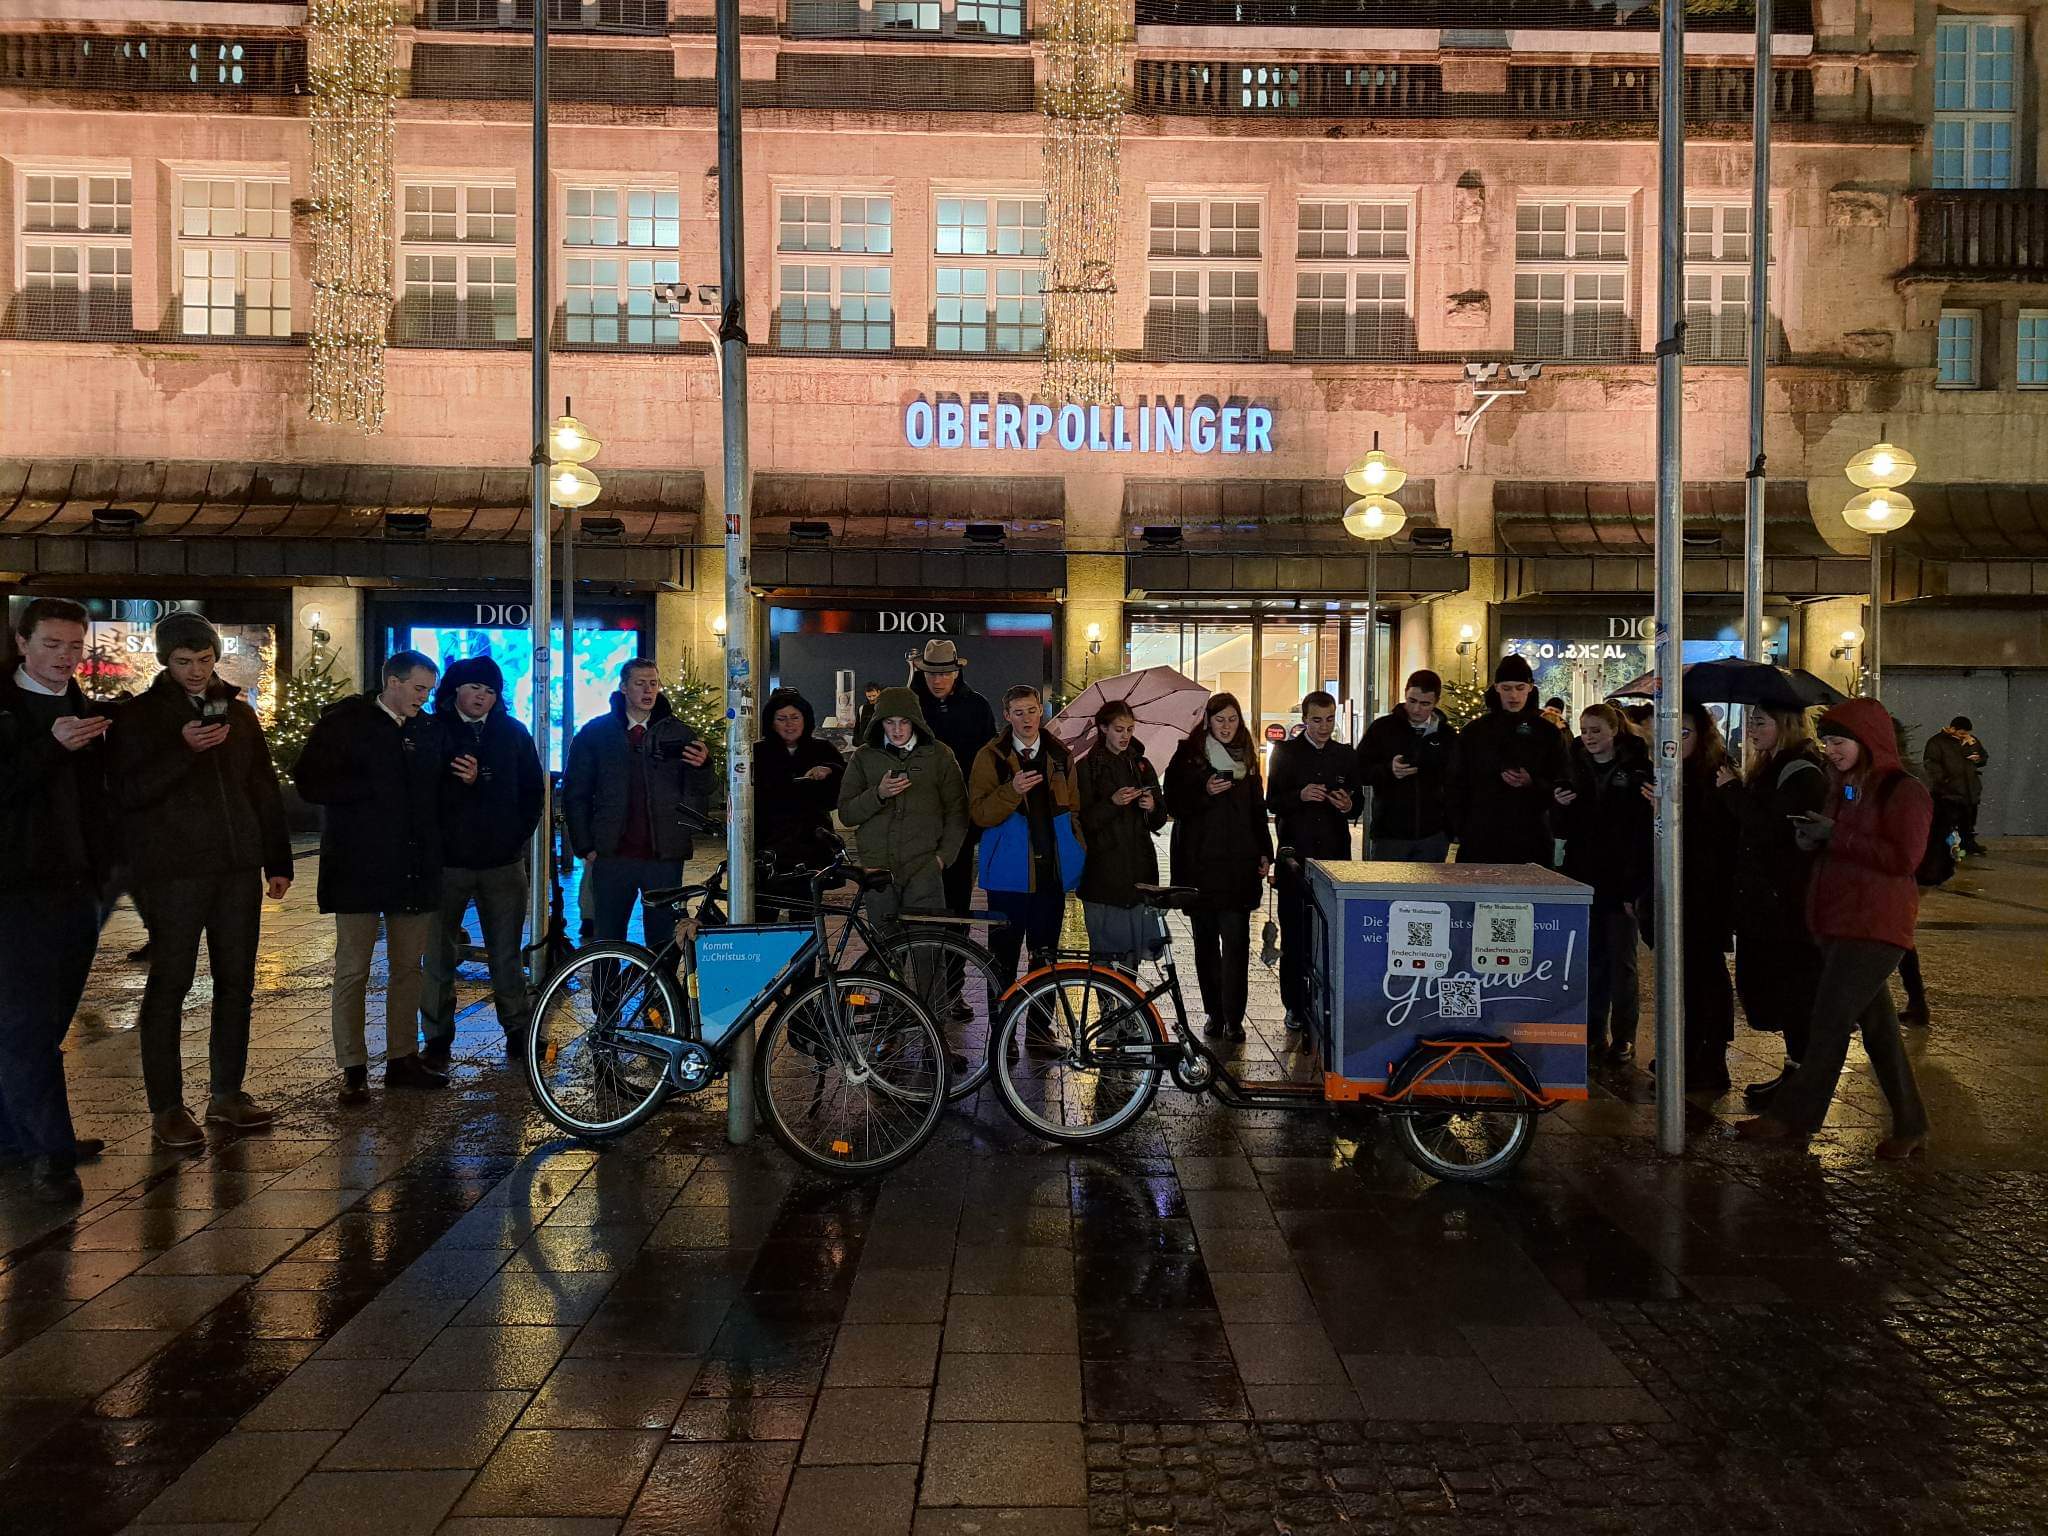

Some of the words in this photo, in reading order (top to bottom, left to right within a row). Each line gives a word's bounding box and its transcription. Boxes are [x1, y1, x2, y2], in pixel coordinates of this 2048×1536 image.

[905, 401, 1273, 453] OBERPOLLINGER
[474, 604, 532, 626] DIO
[877, 611, 947, 633] DIOR
[1363, 915, 1384, 927] Die
[1450, 919, 1464, 929] ist
[1362, 932, 1383, 943] wie
[702, 942, 733, 951] Kommt
[1475, 946, 1532, 956] findechristus.org
[701, 952, 761, 962] zuChristus.org
[1391, 948, 1447, 960] findechristus.org
